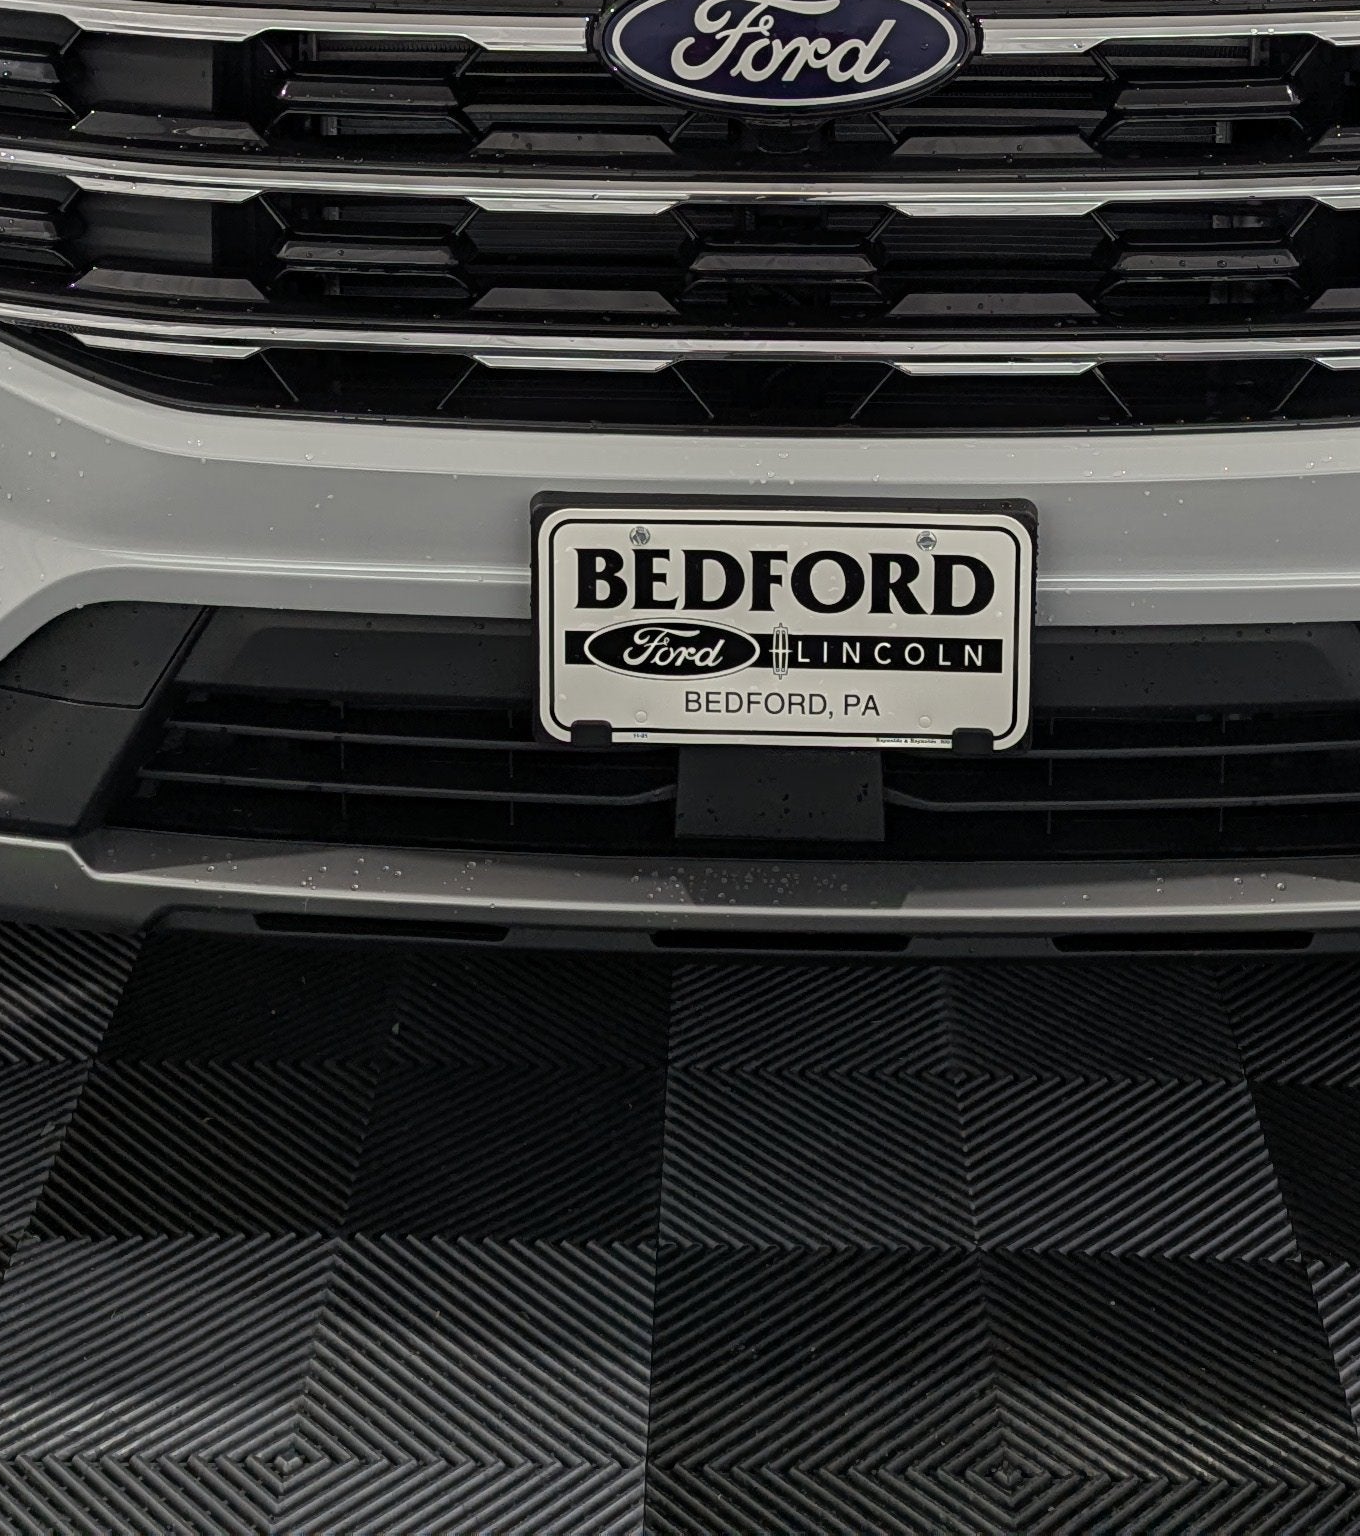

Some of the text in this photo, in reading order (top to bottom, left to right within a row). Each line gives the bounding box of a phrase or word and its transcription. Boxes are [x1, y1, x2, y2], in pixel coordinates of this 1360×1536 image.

[573, 547, 996, 616] BEDFORD
[622, 627, 984, 667] Ford LINCOLN
[684, 690, 881, 720] BEDFORD, PA
